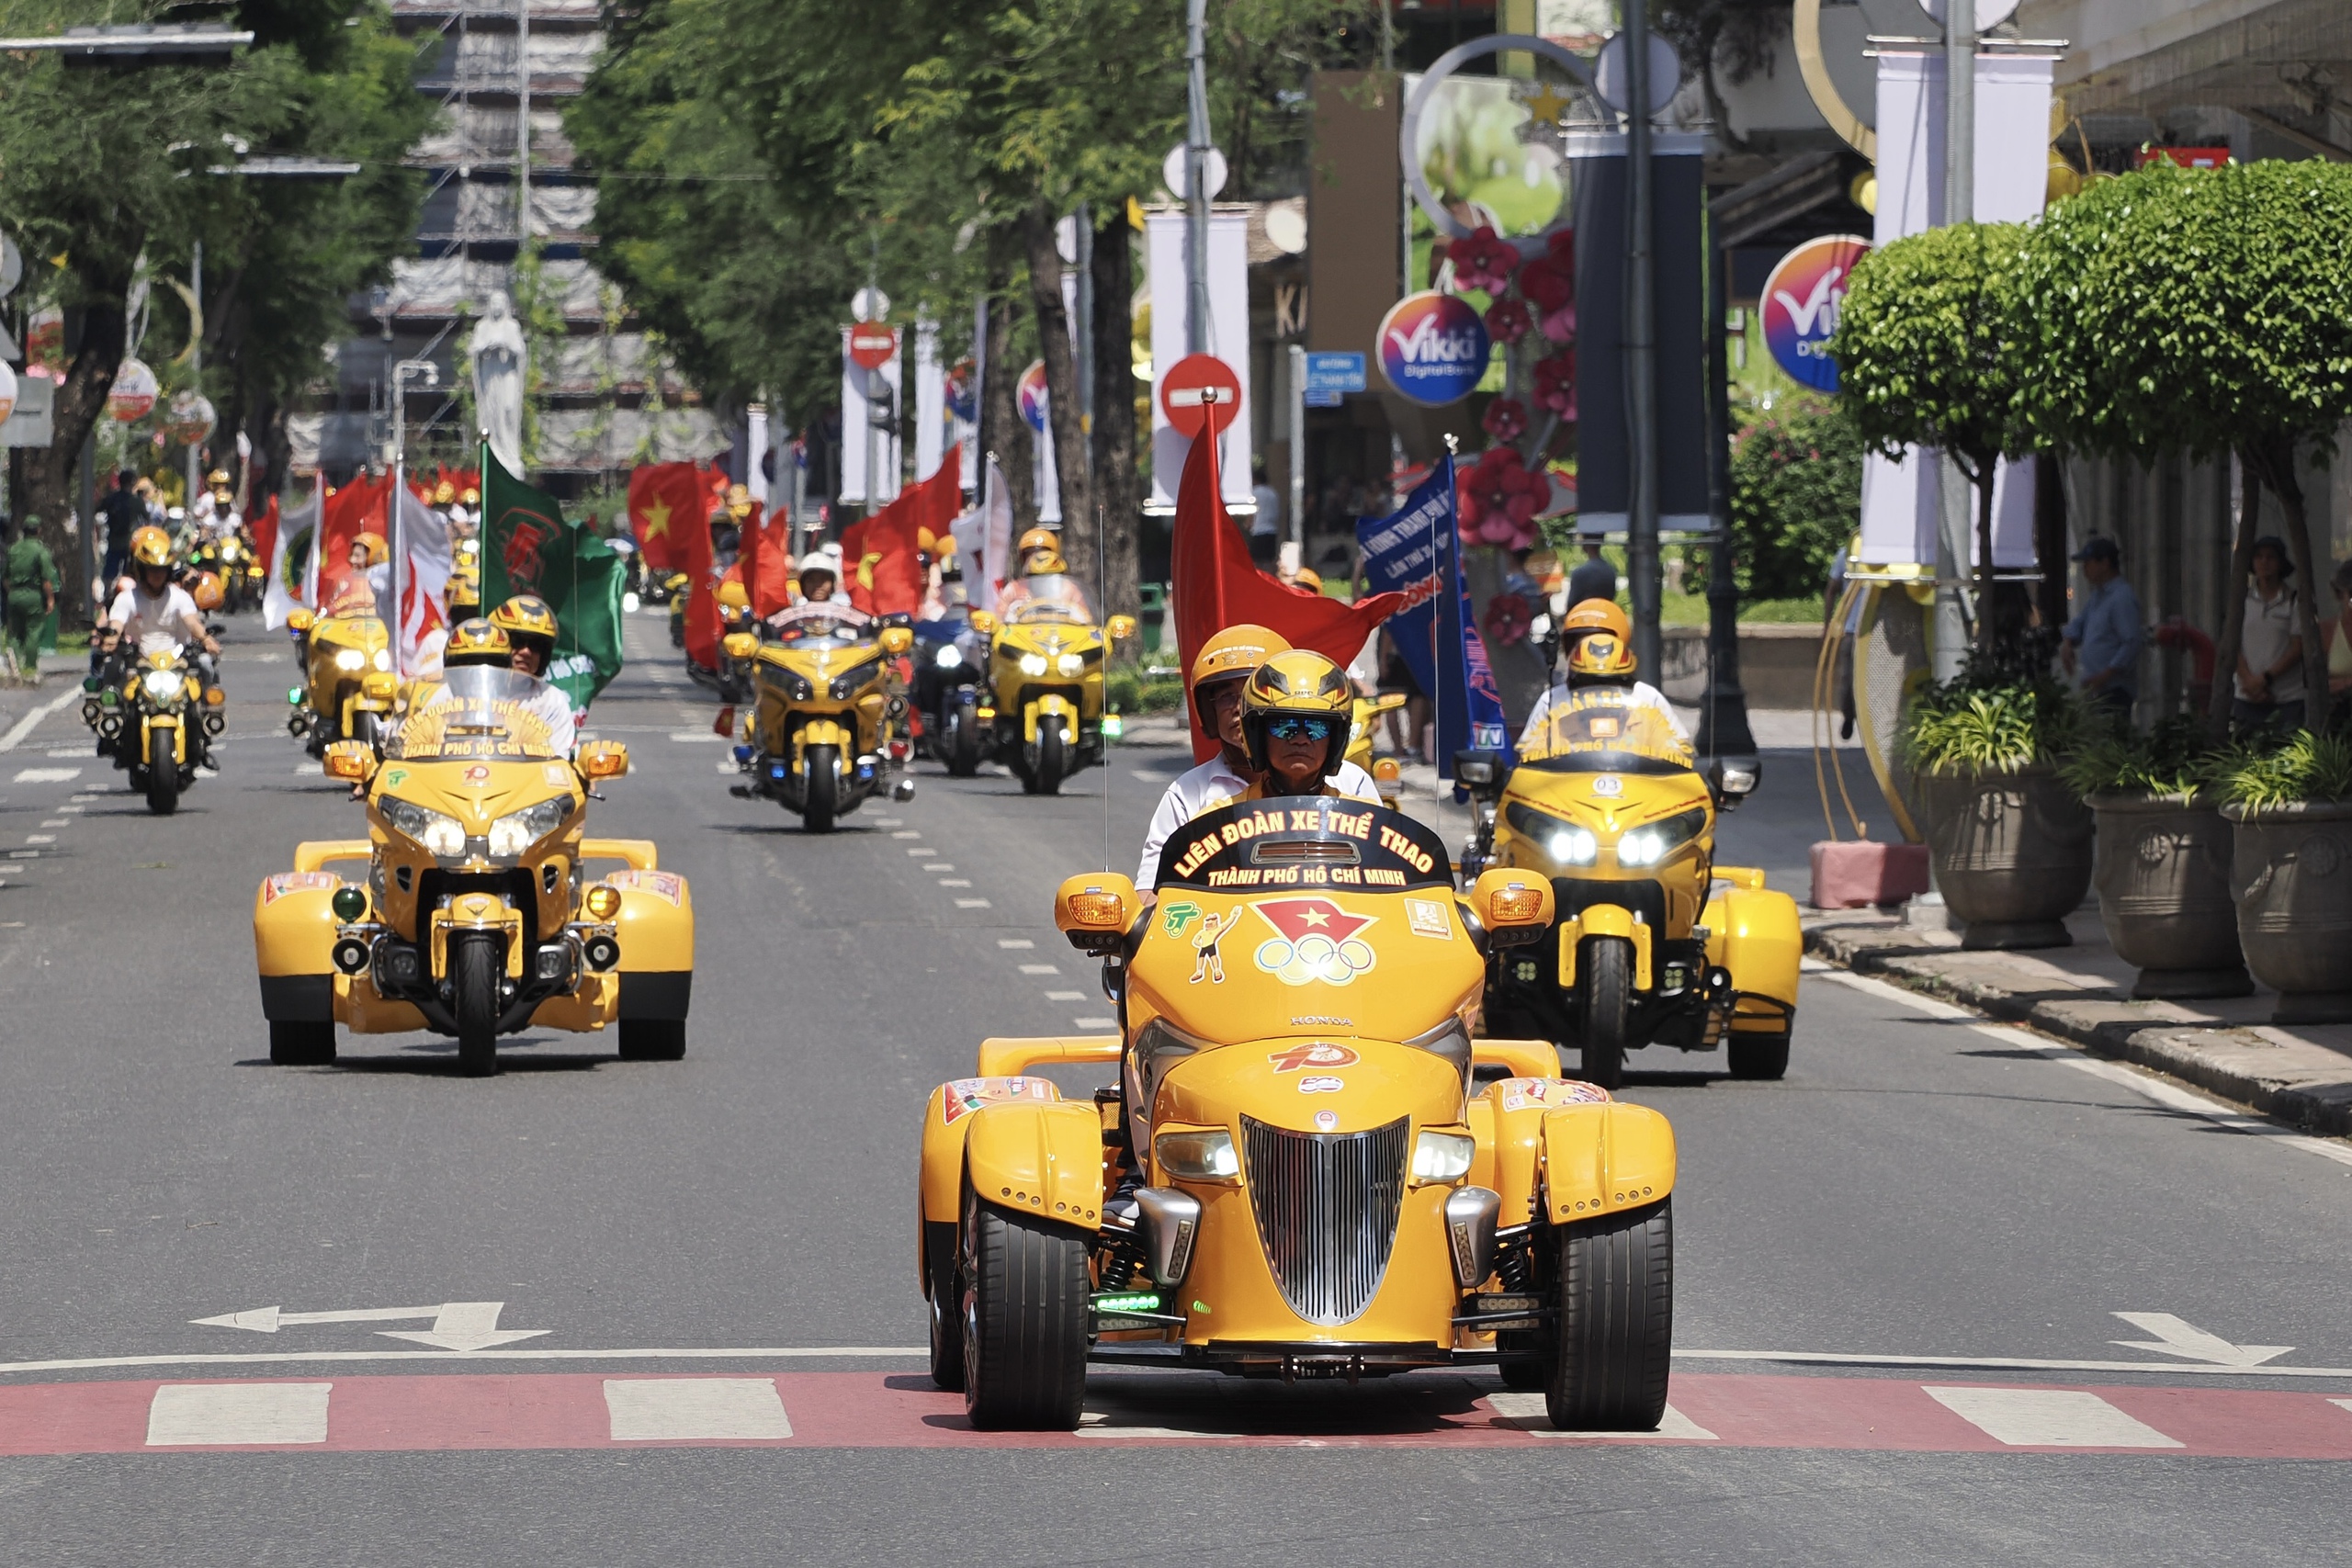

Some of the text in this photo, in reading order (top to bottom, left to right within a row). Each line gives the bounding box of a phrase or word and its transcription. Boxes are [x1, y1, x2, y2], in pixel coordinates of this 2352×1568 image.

[1387, 313, 1476, 363] Vikki
[1596, 779, 1619, 792] 03
[1174, 809, 1435, 878] LIÊN ĐOÀN XE THỂ THAO
[1208, 866, 1261, 887] THÀNH
[1262, 865, 1301, 885] PHỐ
[1330, 866, 1362, 885] CHÍ
[1366, 868, 1408, 886] MINH
[1290, 1016, 1353, 1027] HONDA
